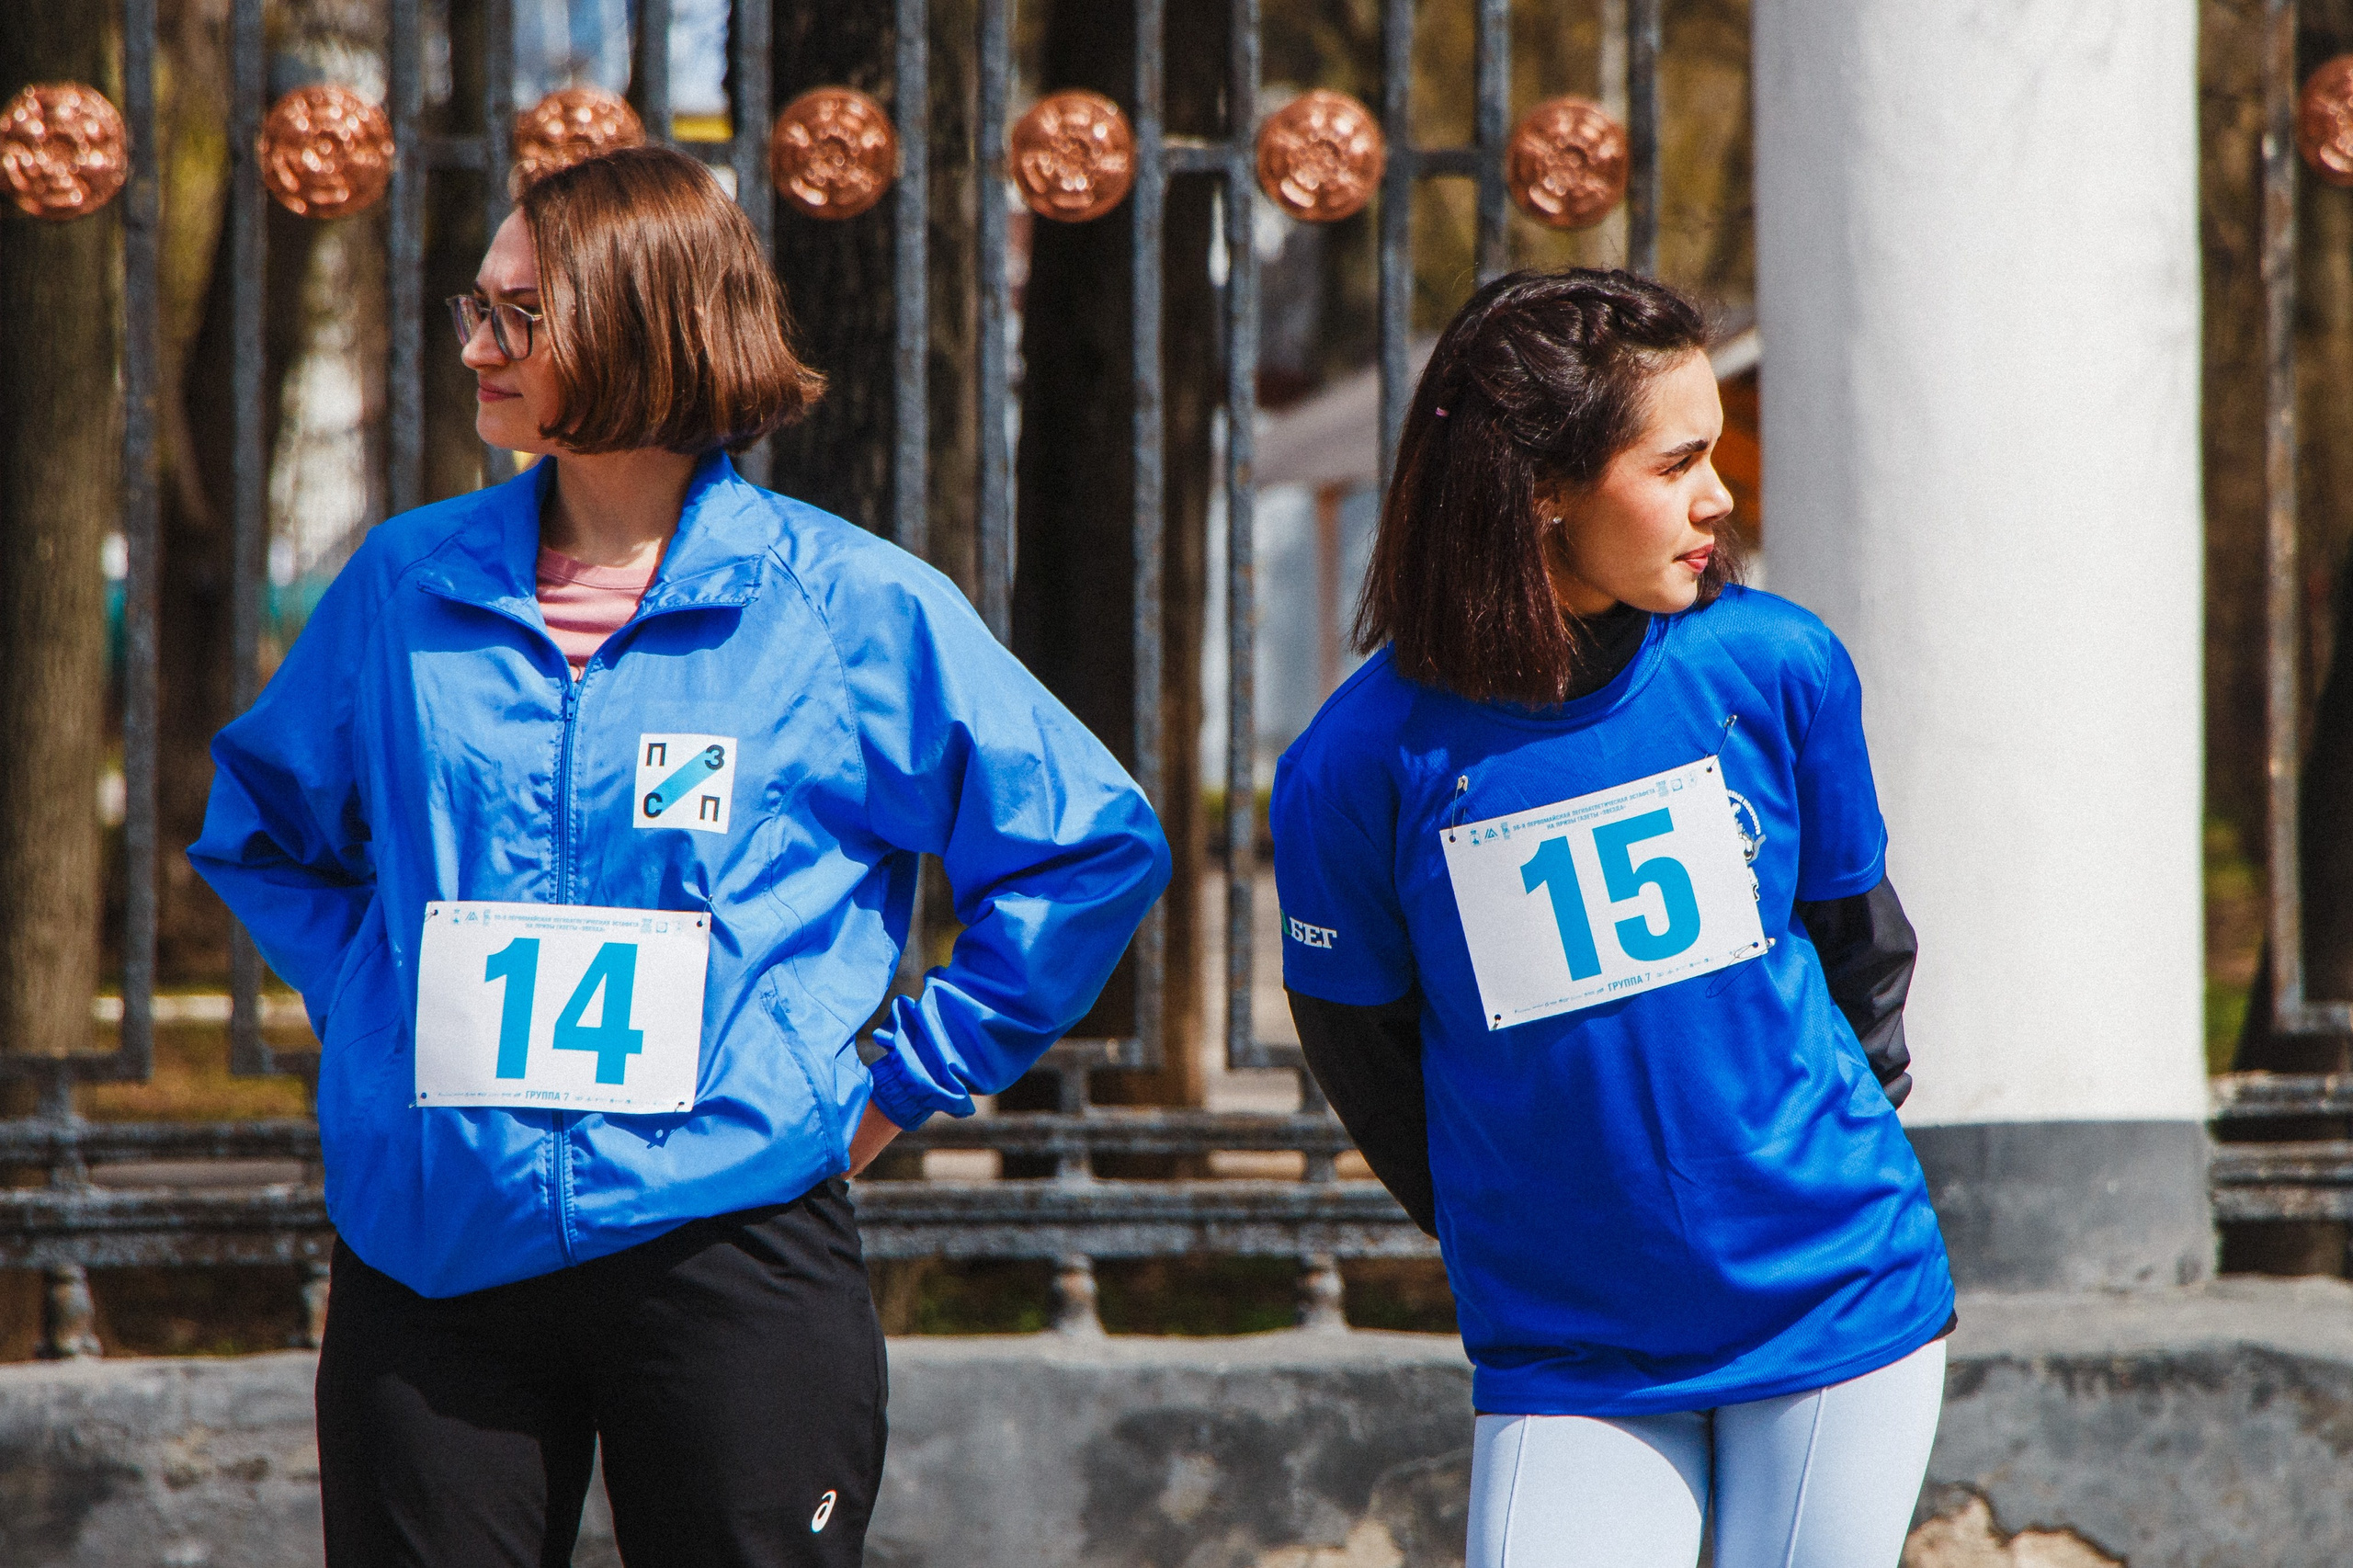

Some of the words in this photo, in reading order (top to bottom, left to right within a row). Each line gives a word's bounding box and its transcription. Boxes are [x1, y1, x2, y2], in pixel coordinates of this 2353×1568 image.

[645, 743, 666, 767] П
[643, 792, 663, 819] С
[699, 794, 721, 823] П
[1527, 812, 1571, 828] ПЕРВОМАЙСКАЯ
[1629, 789, 1655, 801] ЭСТАФЕТА
[1519, 807, 1701, 982] 15
[1289, 916, 1337, 949] БЕГ
[1608, 975, 1643, 992] ГРУППА
[1644, 972, 1651, 981] 7
[484, 937, 643, 1085] 14
[525, 1090, 561, 1100] ГРУППА
[563, 1092, 570, 1101] 7
